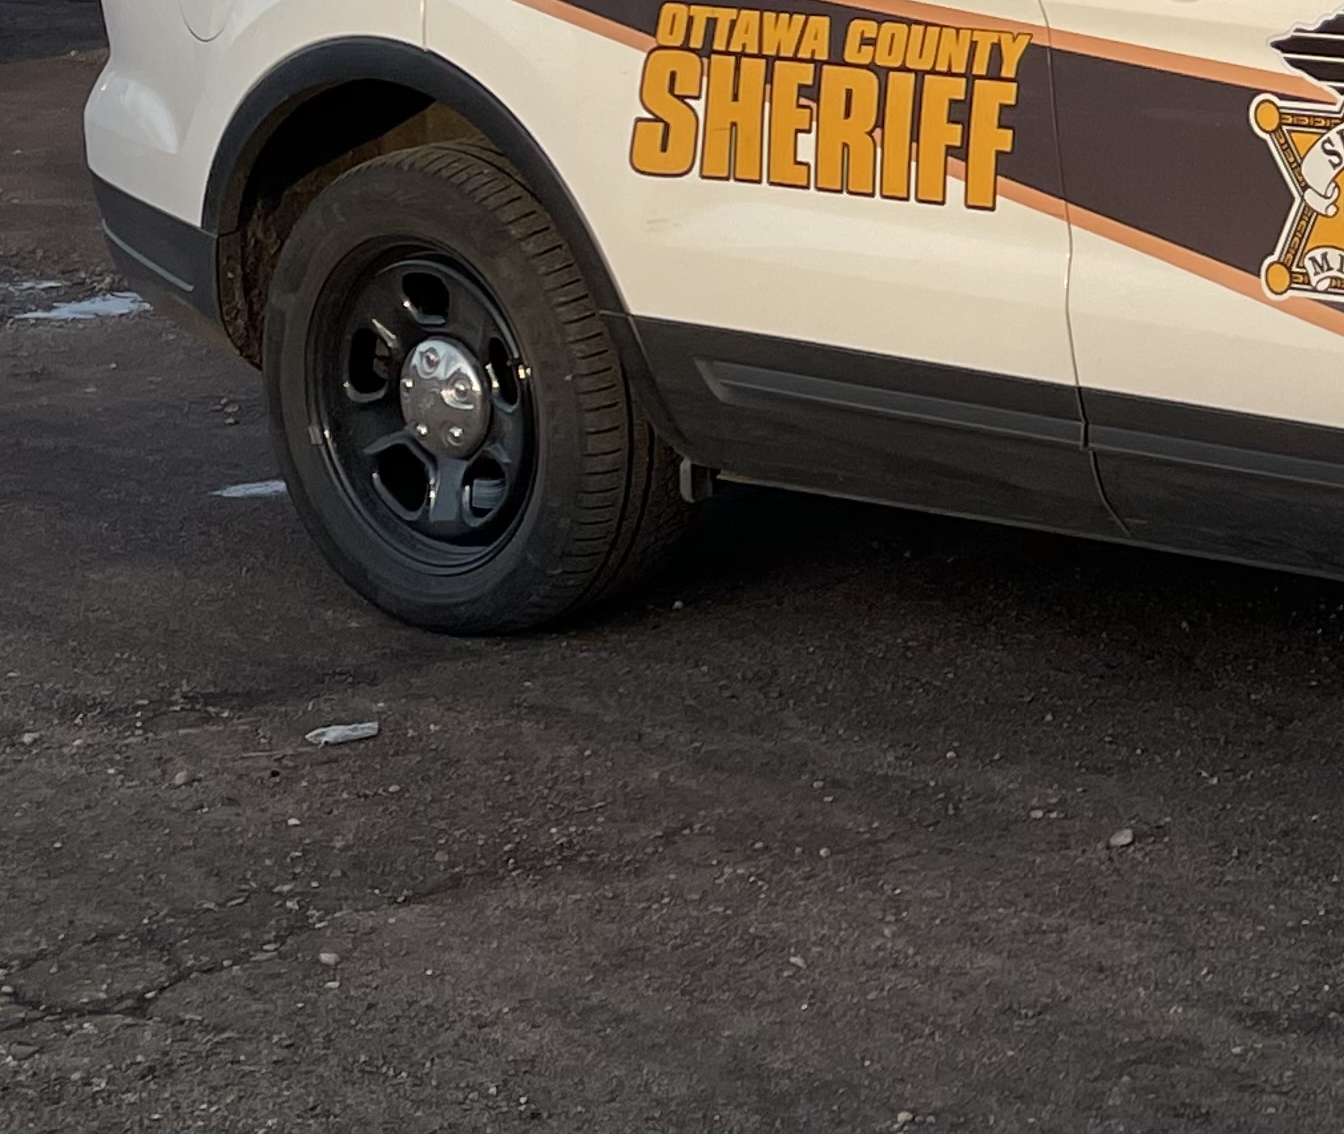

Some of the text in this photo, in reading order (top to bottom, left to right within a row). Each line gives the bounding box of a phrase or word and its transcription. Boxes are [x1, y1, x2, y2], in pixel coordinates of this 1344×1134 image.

[656, 1, 1033, 78] OTTAWA COUNTY
[629, 47, 1019, 212] SHERIFF
